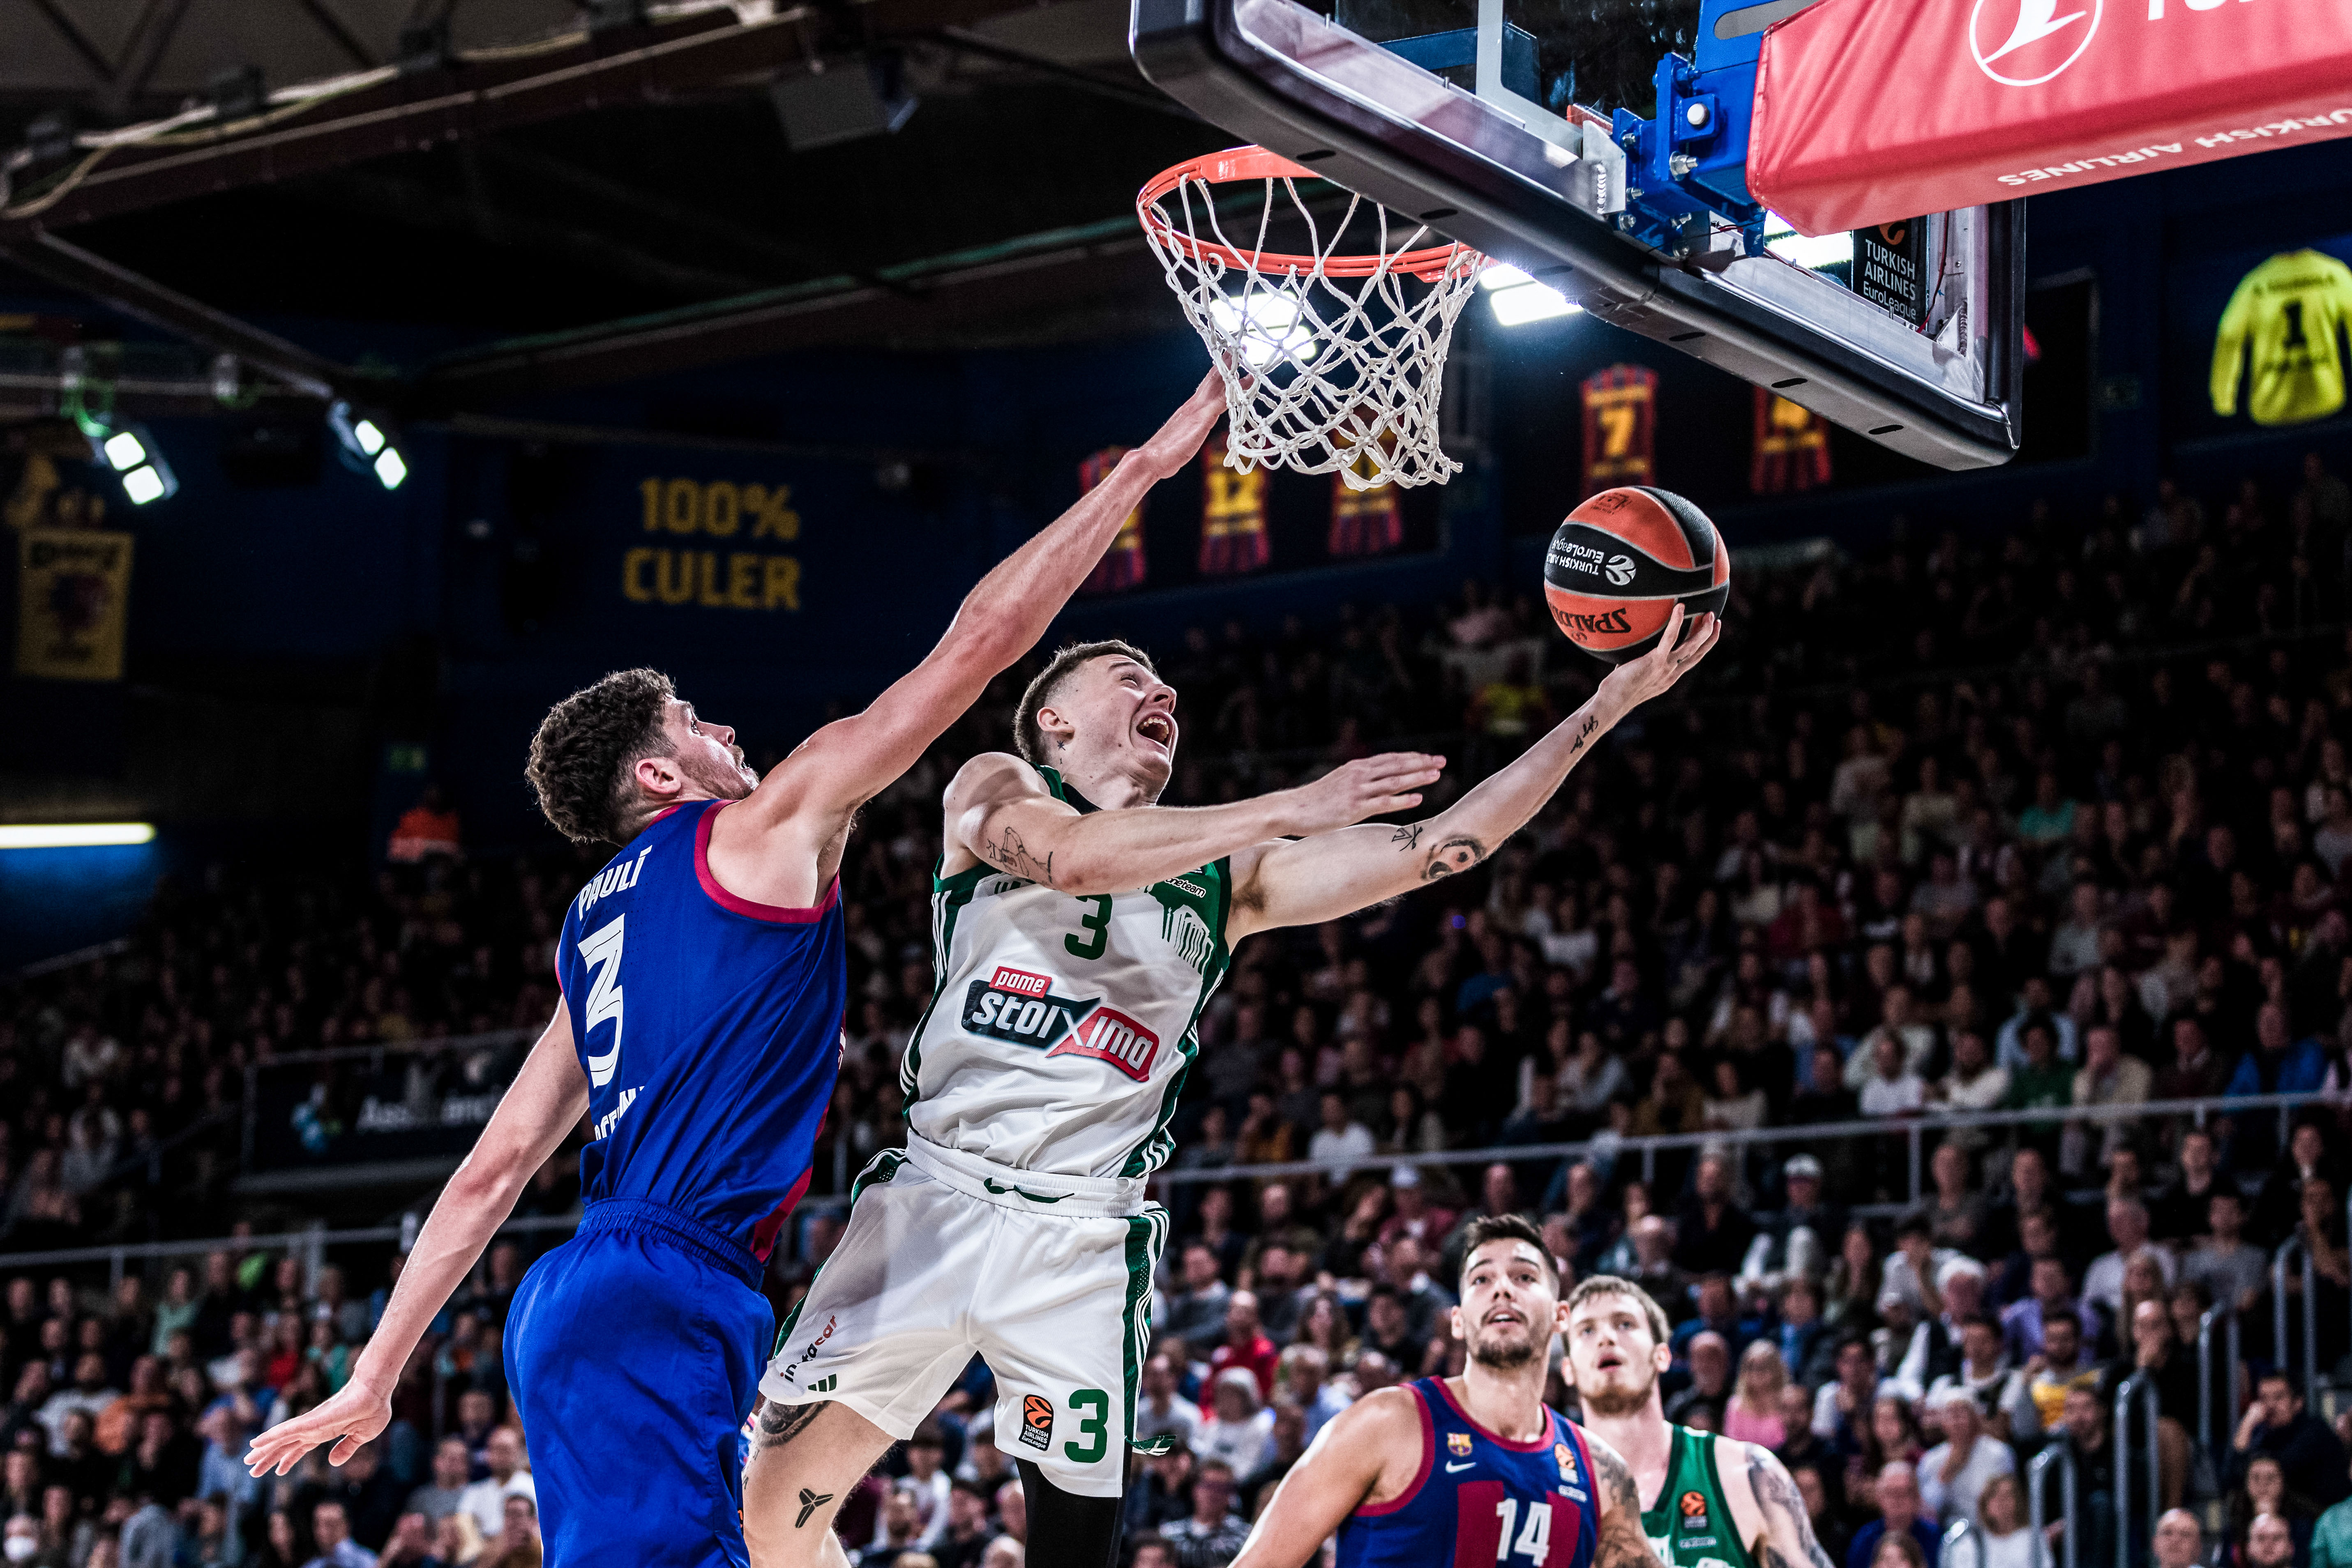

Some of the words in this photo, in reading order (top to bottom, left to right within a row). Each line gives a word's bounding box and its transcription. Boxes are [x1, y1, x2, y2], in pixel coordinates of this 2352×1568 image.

[2195, 108, 2352, 148] URKISH
[1997, 143, 2183, 186] AIRLINES
[1864, 261, 1915, 301] AIRLINES
[1865, 239, 1915, 280] TURKISH
[1863, 281, 1916, 320] EuroLeague
[1599, 405, 1636, 457] 7
[639, 477, 800, 541] 100%
[622, 546, 800, 612] CULER
[1559, 555, 1599, 576] TURKISH
[579, 845, 653, 921] PAULÍ
[1064, 893, 1113, 960] 3
[578, 913, 625, 1089] 3
[995, 971, 1045, 993] pame
[780, 1315, 837, 1383] intacar
[1022, 1435, 1046, 1448] EuroLeague
[1024, 1430, 1047, 1444] AIRLINES
[1025, 1424, 1049, 1438] TURKISH
[1064, 1389, 1109, 1462] 3
[1496, 1498, 1552, 1567] 14
